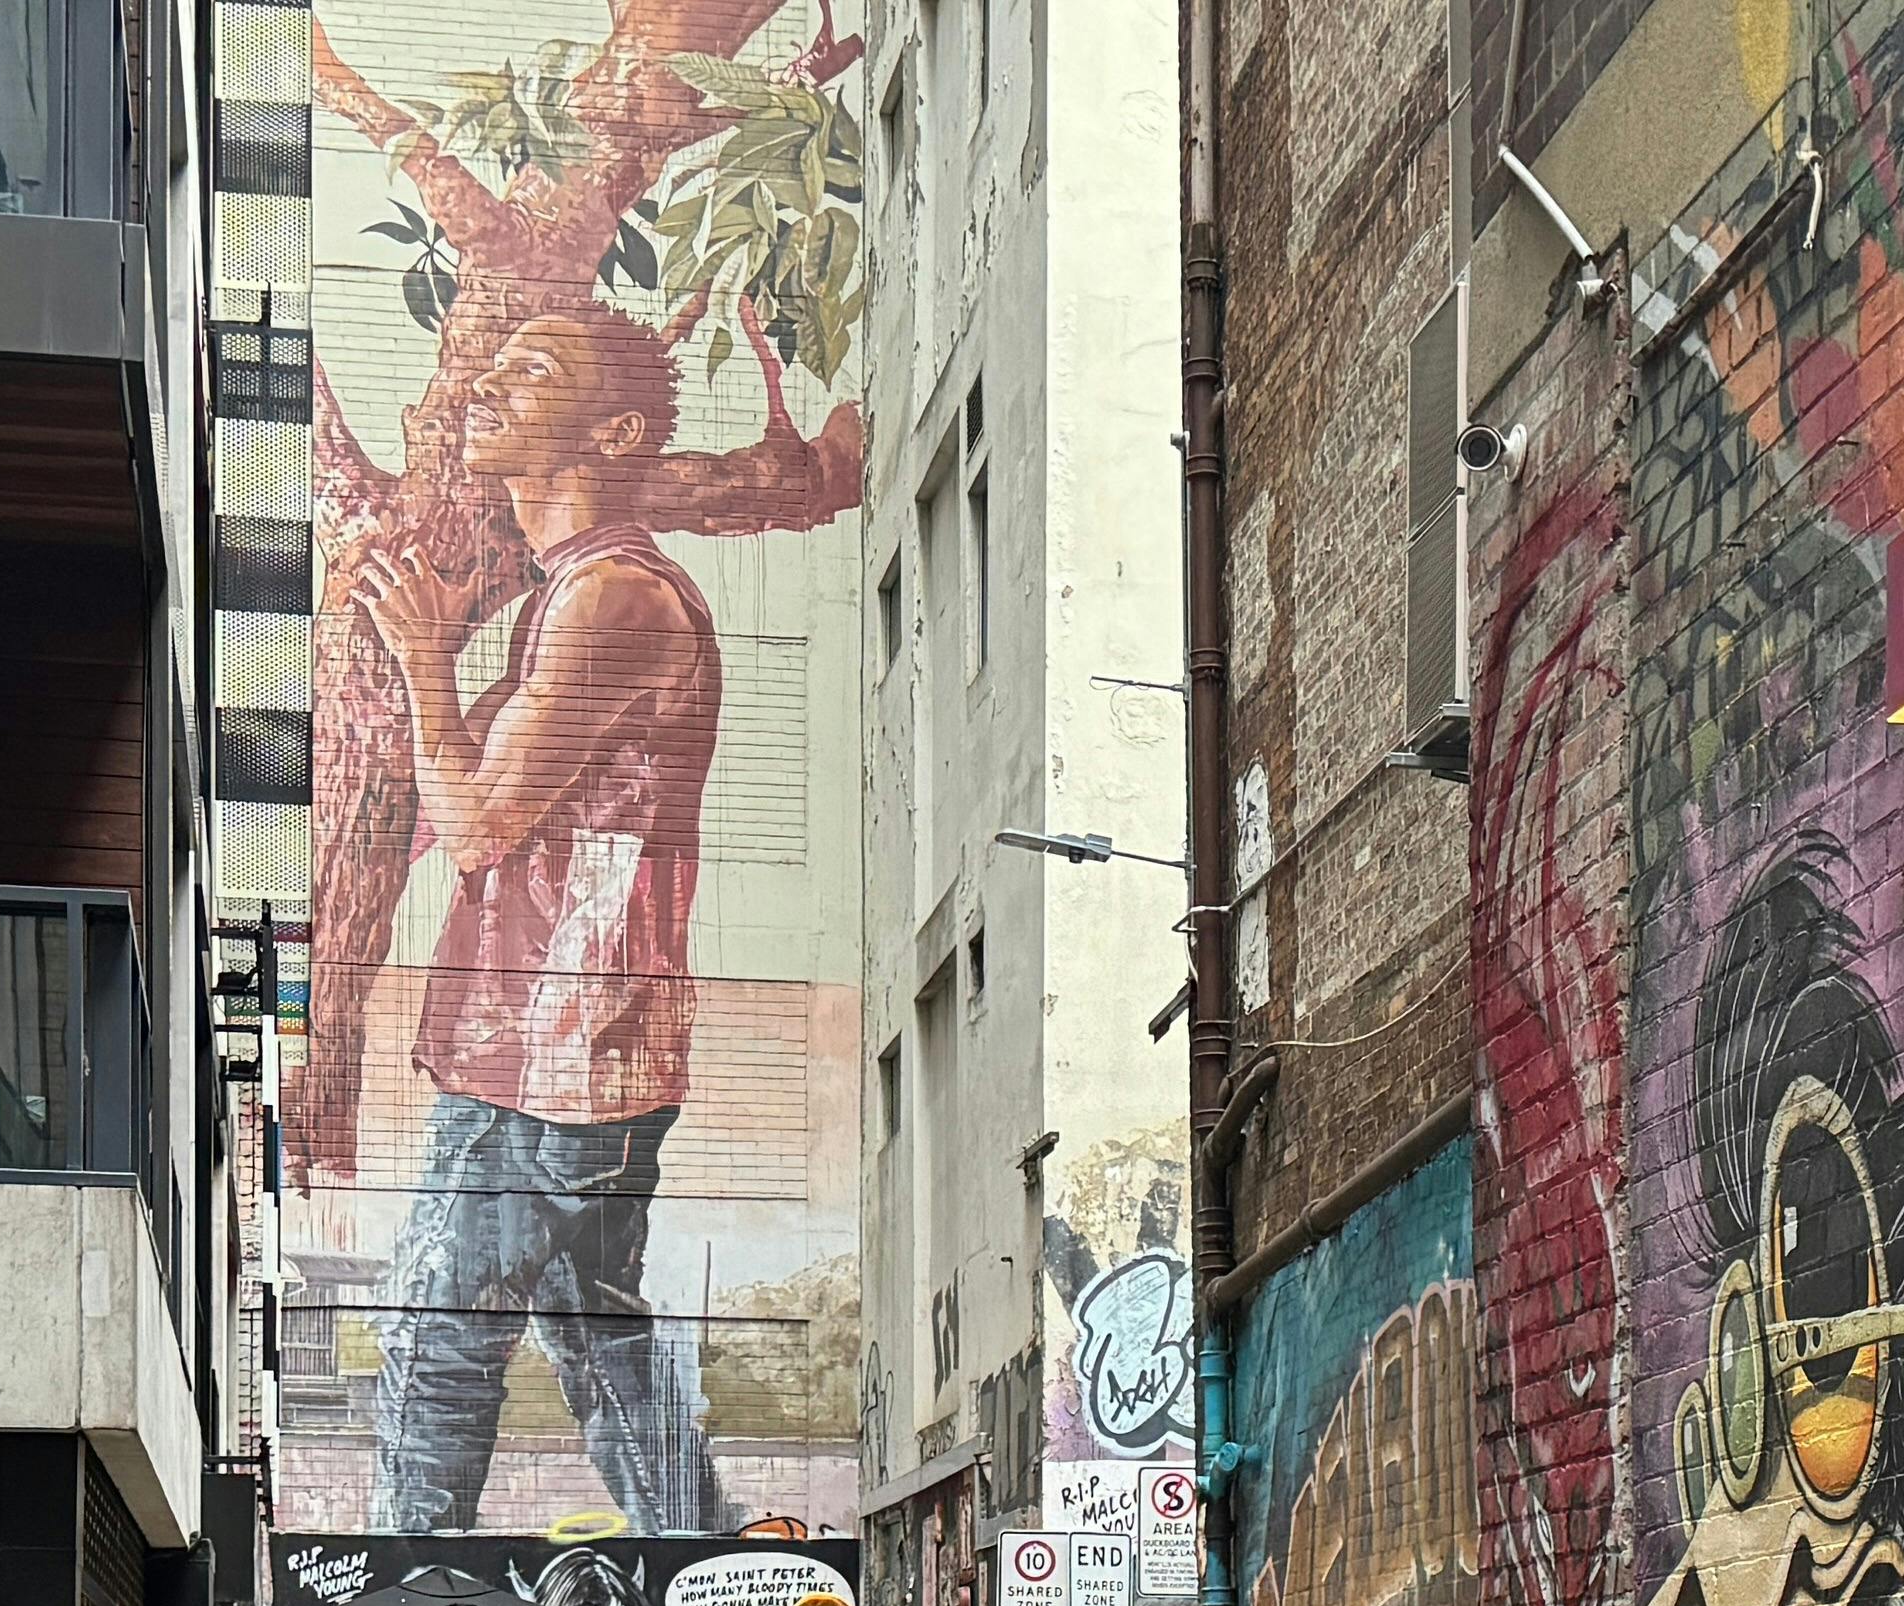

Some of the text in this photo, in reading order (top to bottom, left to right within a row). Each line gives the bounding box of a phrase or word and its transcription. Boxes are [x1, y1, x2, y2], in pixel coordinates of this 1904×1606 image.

[1153, 1522, 1194, 1535] AREA
[1025, 1552, 1045, 1570] 10
[1077, 1545, 1123, 1567] END
[299, 1551, 369, 1589] MALCOLM
[726, 1568, 767, 1584] SAINT
[772, 1566, 816, 1581] PETER
[313, 1569, 375, 1599] YOUNG
[681, 1590, 707, 1603] HOW
[710, 1584, 743, 1598] MANY
[747, 1582, 793, 1594] BLOODY
[1007, 1586, 1063, 1598] SHARED
[1076, 1579, 1124, 1592] SHARED
[1084, 1594, 1116, 1606] ZONE
